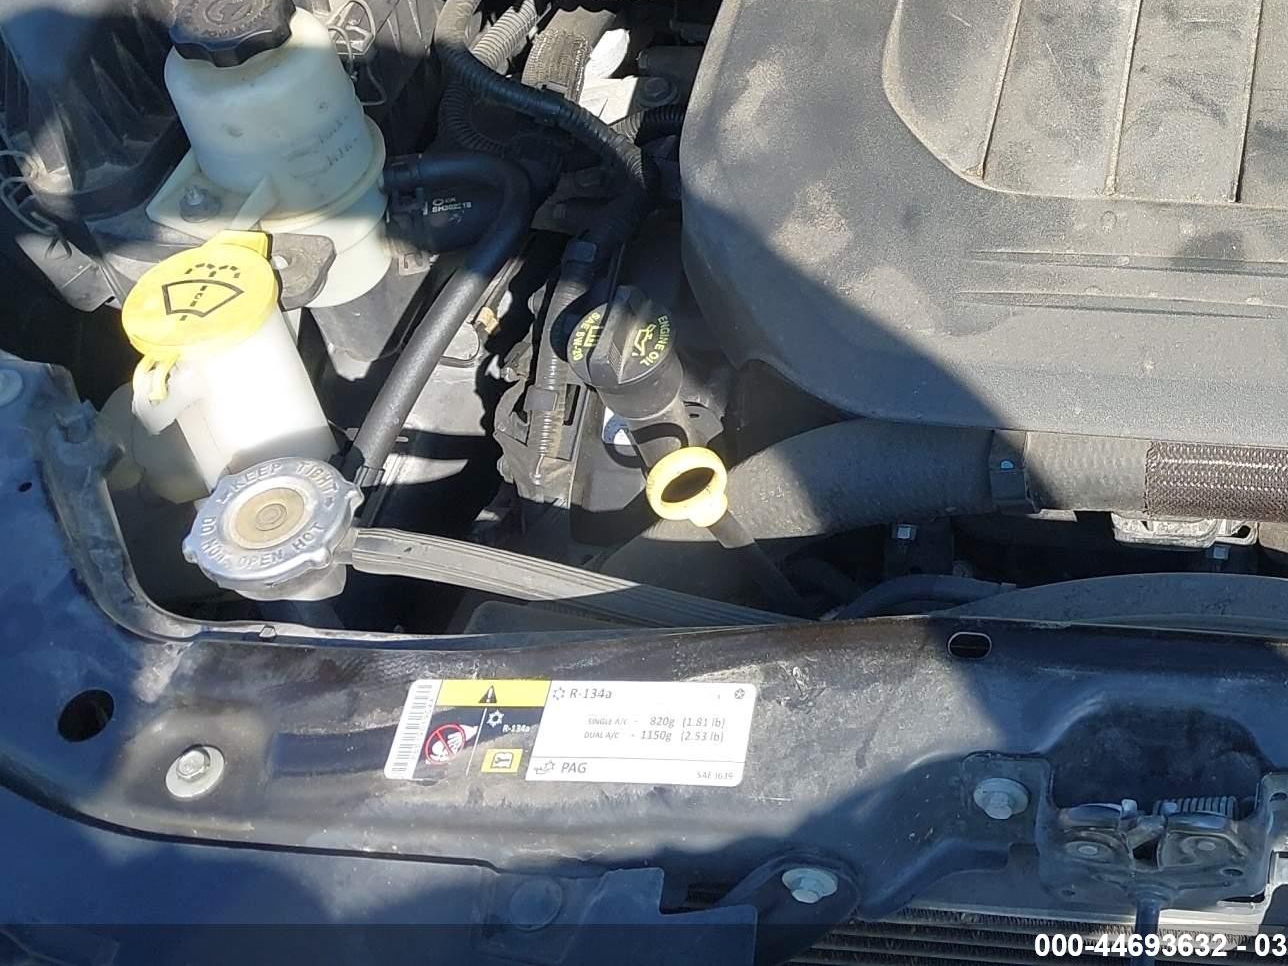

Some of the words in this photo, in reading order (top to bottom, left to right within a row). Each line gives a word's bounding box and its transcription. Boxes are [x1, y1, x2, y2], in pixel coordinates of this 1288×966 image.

[580, 312, 600, 332] SAE
[654, 315, 670, 352] ENGINE
[640, 352, 660, 366] OIL
[234, 463, 282, 494] KEEP
[295, 462, 339, 495] TIGHT
[238, 549, 285, 571] OPEN
[293, 522, 325, 554] HOT
[569, 688, 612, 699] R-134a
[650, 716, 675, 728] 820g
[640, 730, 672, 742] 1150g
[561, 762, 588, 774] PAG
